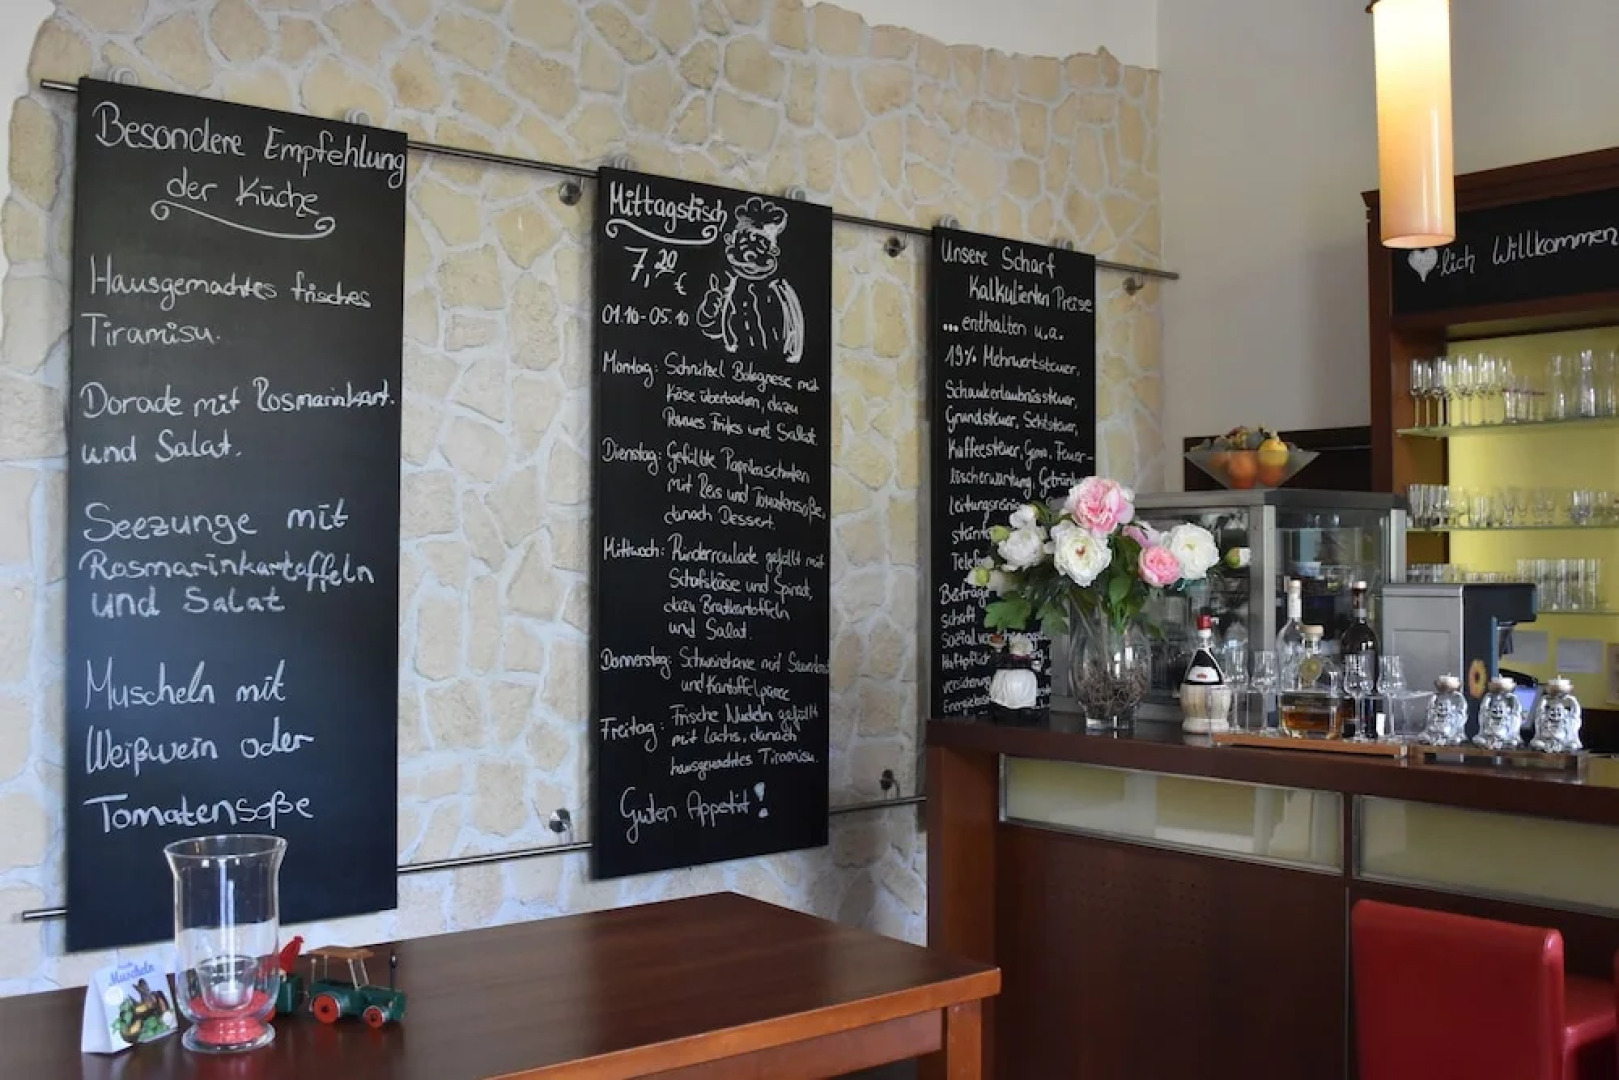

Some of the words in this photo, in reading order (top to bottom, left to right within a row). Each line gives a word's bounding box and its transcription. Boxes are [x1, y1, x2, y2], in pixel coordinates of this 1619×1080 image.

[92, 101, 247, 156] Besondere
[264, 125, 406, 189] Empfehlung
[166, 166, 218, 202] der
[236, 176, 319, 217] Küche
[609, 181, 728, 233] Mittagstisch
[941, 237, 989, 266] Unsere
[1001, 246, 1056, 279] Scharf
[1492, 227, 1619, 265] Willkommen
[89, 254, 278, 311] Hausgemachtes
[291, 271, 372, 308] frisches
[969, 275, 1050, 307] Kalkulierten
[1052, 286, 1093, 313] Preise
[81, 313, 221, 347] Tiramisu.
[603, 350, 659, 388] Montag:
[664, 351, 725, 378] Schnitzel
[732, 360, 792, 393] Bolognese
[797, 376, 819, 393] mit
[944, 344, 977, 367] 19%
[80, 381, 184, 419] Dorade
[193, 386, 240, 417] mit
[252, 376, 395, 413] Rosmarinkart.
[666, 383, 697, 403] Käse
[767, 394, 799, 415] dazu
[662, 405, 707, 430] Pommes
[709, 412, 743, 436] Frites
[747, 420, 771, 440] und
[776, 422, 819, 446] Salat
[81, 434, 137, 464] und
[154, 428, 242, 462] Salat.
[602, 437, 662, 477] Dienstag:
[666, 440, 717, 474] Gefüllte
[1054, 440, 1094, 464] Feuer-
[698, 472, 723, 500] Reis
[727, 484, 749, 505] und
[84, 502, 257, 545] Seezunge
[287, 498, 349, 531] mit
[664, 504, 714, 525] danach
[603, 536, 665, 561] Mittwoch:
[667, 533, 759, 565] Rinderroulade
[805, 553, 825, 569] mit
[79, 549, 375, 592] Rosmarinkartoffeln
[668, 567, 742, 592] Schafskäse
[745, 574, 769, 595] und
[91, 586, 160, 618] und
[183, 586, 286, 614] Salat
[663, 596, 696, 613] dazu
[699, 593, 790, 621] Bratkartoffeln
[668, 617, 696, 638] und
[600, 645, 672, 679] Donnerstag:
[761, 652, 783, 673] mit
[85, 656, 216, 711] Muscheln
[236, 659, 286, 702] mit
[681, 672, 704, 693] und
[86, 725, 218, 776] Weißwein
[240, 716, 314, 759] oder
[600, 715, 665, 752] Freitag:
[669, 703, 720, 726] Frische
[725, 703, 774, 723] Nudeln
[671, 728, 698, 747] mit
[750, 724, 798, 743] danach
[670, 752, 753, 781] hausgemachtes
[83, 790, 315, 833] Tomatensoße
[620, 786, 678, 844] Guten
